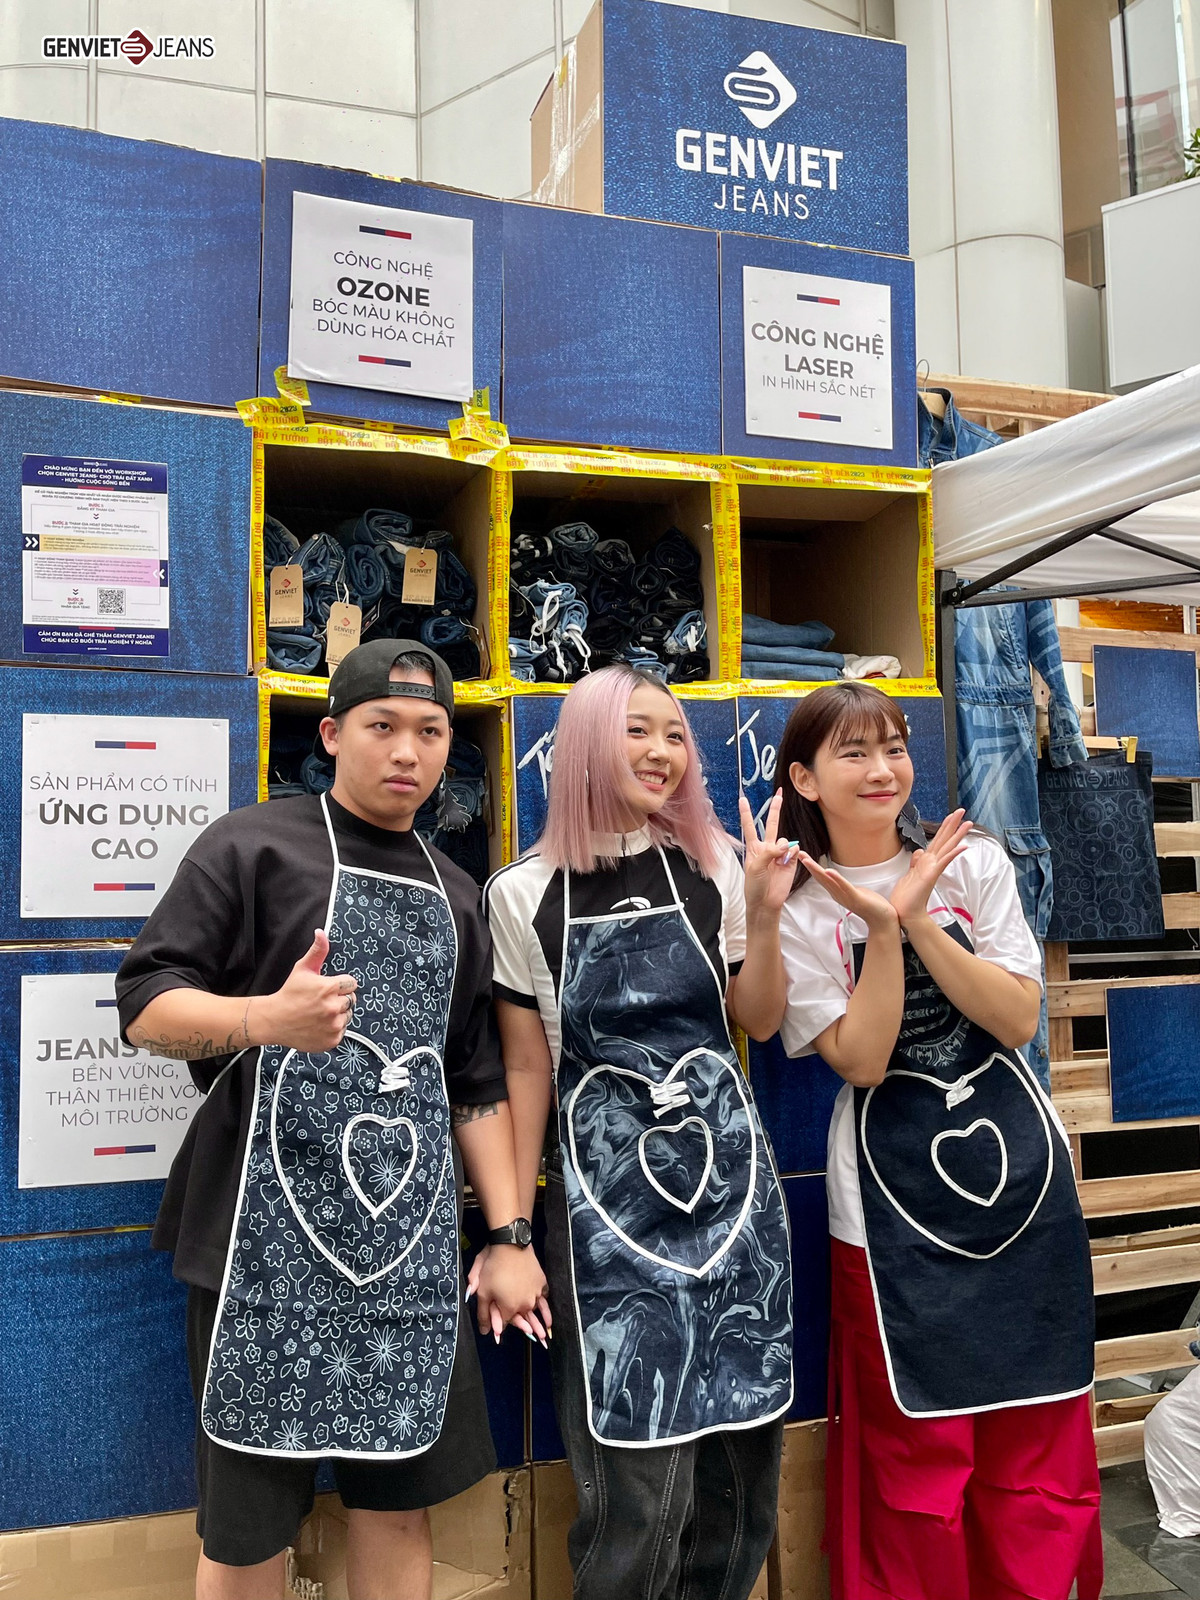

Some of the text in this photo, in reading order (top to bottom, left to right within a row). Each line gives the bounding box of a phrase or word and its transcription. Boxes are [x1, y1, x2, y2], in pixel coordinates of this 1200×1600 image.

[675, 128, 844, 191] GENVIET
[713, 183, 810, 220] JEANS
[333, 250, 433, 280] CÔNG NGHỆ
[337, 276, 430, 307] OZONE
[312, 298, 455, 329] BÓC MÀU KHÔNG
[317, 318, 455, 348] DÙNG HÓA CHẤT
[751, 320, 884, 360] CÔNG NGHỆ
[785, 354, 854, 379] LASER
[762, 375, 876, 399] IN HÌNH SẮC NÉT
[409, 567, 433, 575] GENVIET
[274, 588, 298, 596] GENVIET
[37, 629, 51, 637] CẢM
[74, 630, 83, 638] ĐÃ
[70, 636, 79, 644] CÓ
[107, 638, 130, 646] NGHIỆM
[333, 625, 356, 635] GENVIET
[29, 772, 217, 792] SẢN PHẨM CÓ TÍNH
[1045, 768, 1129, 789] GENVIET JEANS
[39, 797, 209, 831] ỨNG DỤNG
[91, 838, 158, 860] CAO
[36, 1037, 138, 1062] JEANS
[72, 1062, 179, 1082] BỀN VỮNG,
[45, 1087, 100, 1106] THÂN
[106, 1084, 164, 1104] THIỆN
[61, 1105, 188, 1127] MÔI TRƯỜNG
